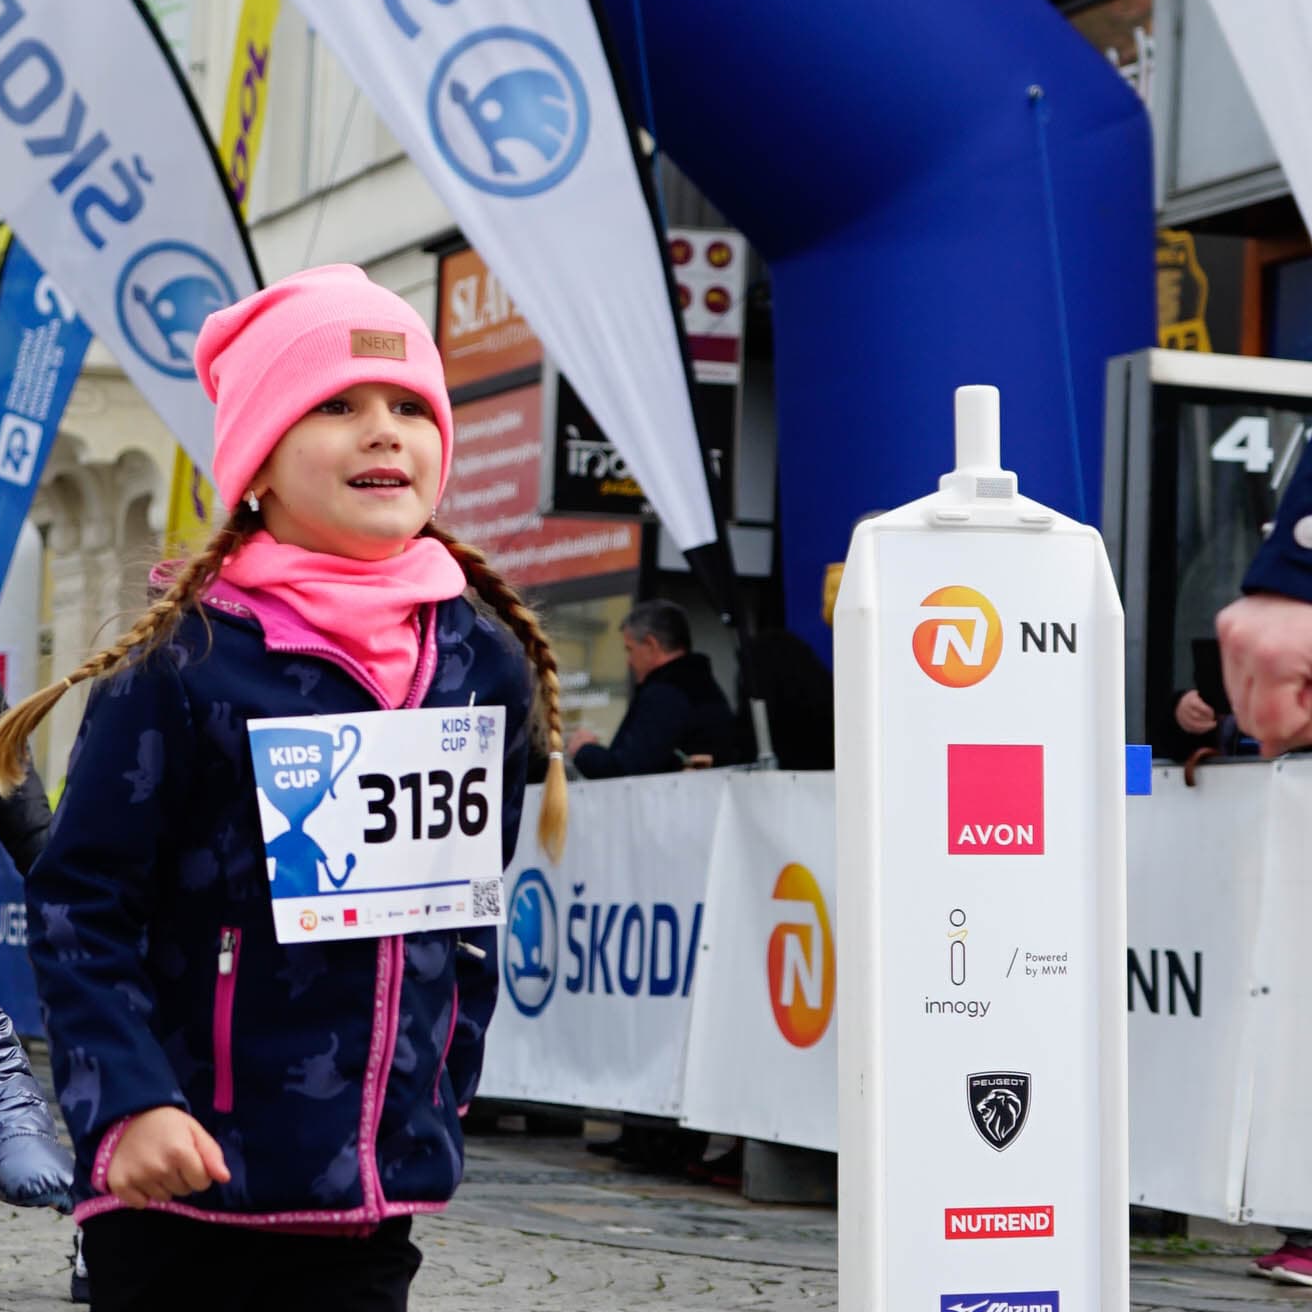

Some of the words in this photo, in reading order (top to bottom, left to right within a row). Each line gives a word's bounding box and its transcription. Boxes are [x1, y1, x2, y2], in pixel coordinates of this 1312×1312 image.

[1020, 621, 1077, 654] NN
[441, 718, 471, 733] KIDS
[269, 745, 322, 766] KIDS
[441, 738, 467, 753] CUP
[274, 769, 320, 789] CUP
[358, 767, 489, 844] 3136
[957, 825, 1034, 845] AVON
[1025, 952, 1068, 963] Powered
[1025, 966, 1038, 977] by
[1041, 966, 1068, 976] MVM
[925, 997, 991, 1018] innogy
[972, 1078, 1026, 1087] PEUGEOT
[951, 1212, 1050, 1233] NUTREND
